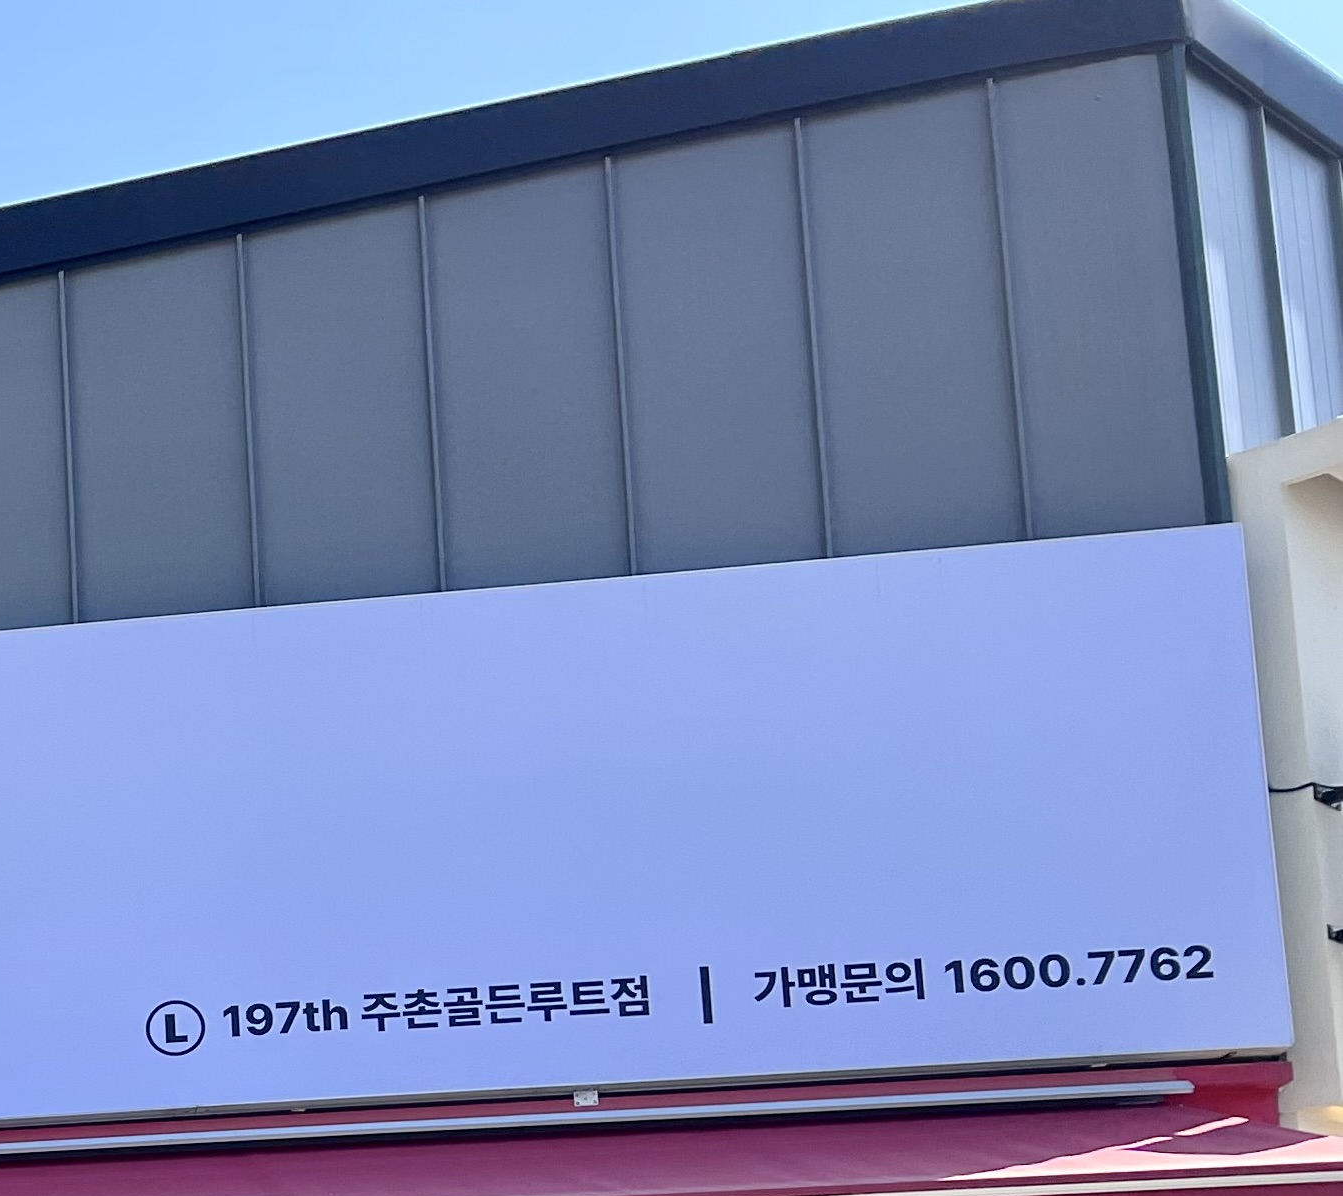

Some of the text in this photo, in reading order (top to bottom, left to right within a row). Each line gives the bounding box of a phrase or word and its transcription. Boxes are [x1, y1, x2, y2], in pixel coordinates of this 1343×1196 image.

[223, 999, 349, 1037] 197th
[360, 975, 651, 1032] 주촌골든루트점
[754, 944, 1214, 1008] 가맹문의 1600.7762
